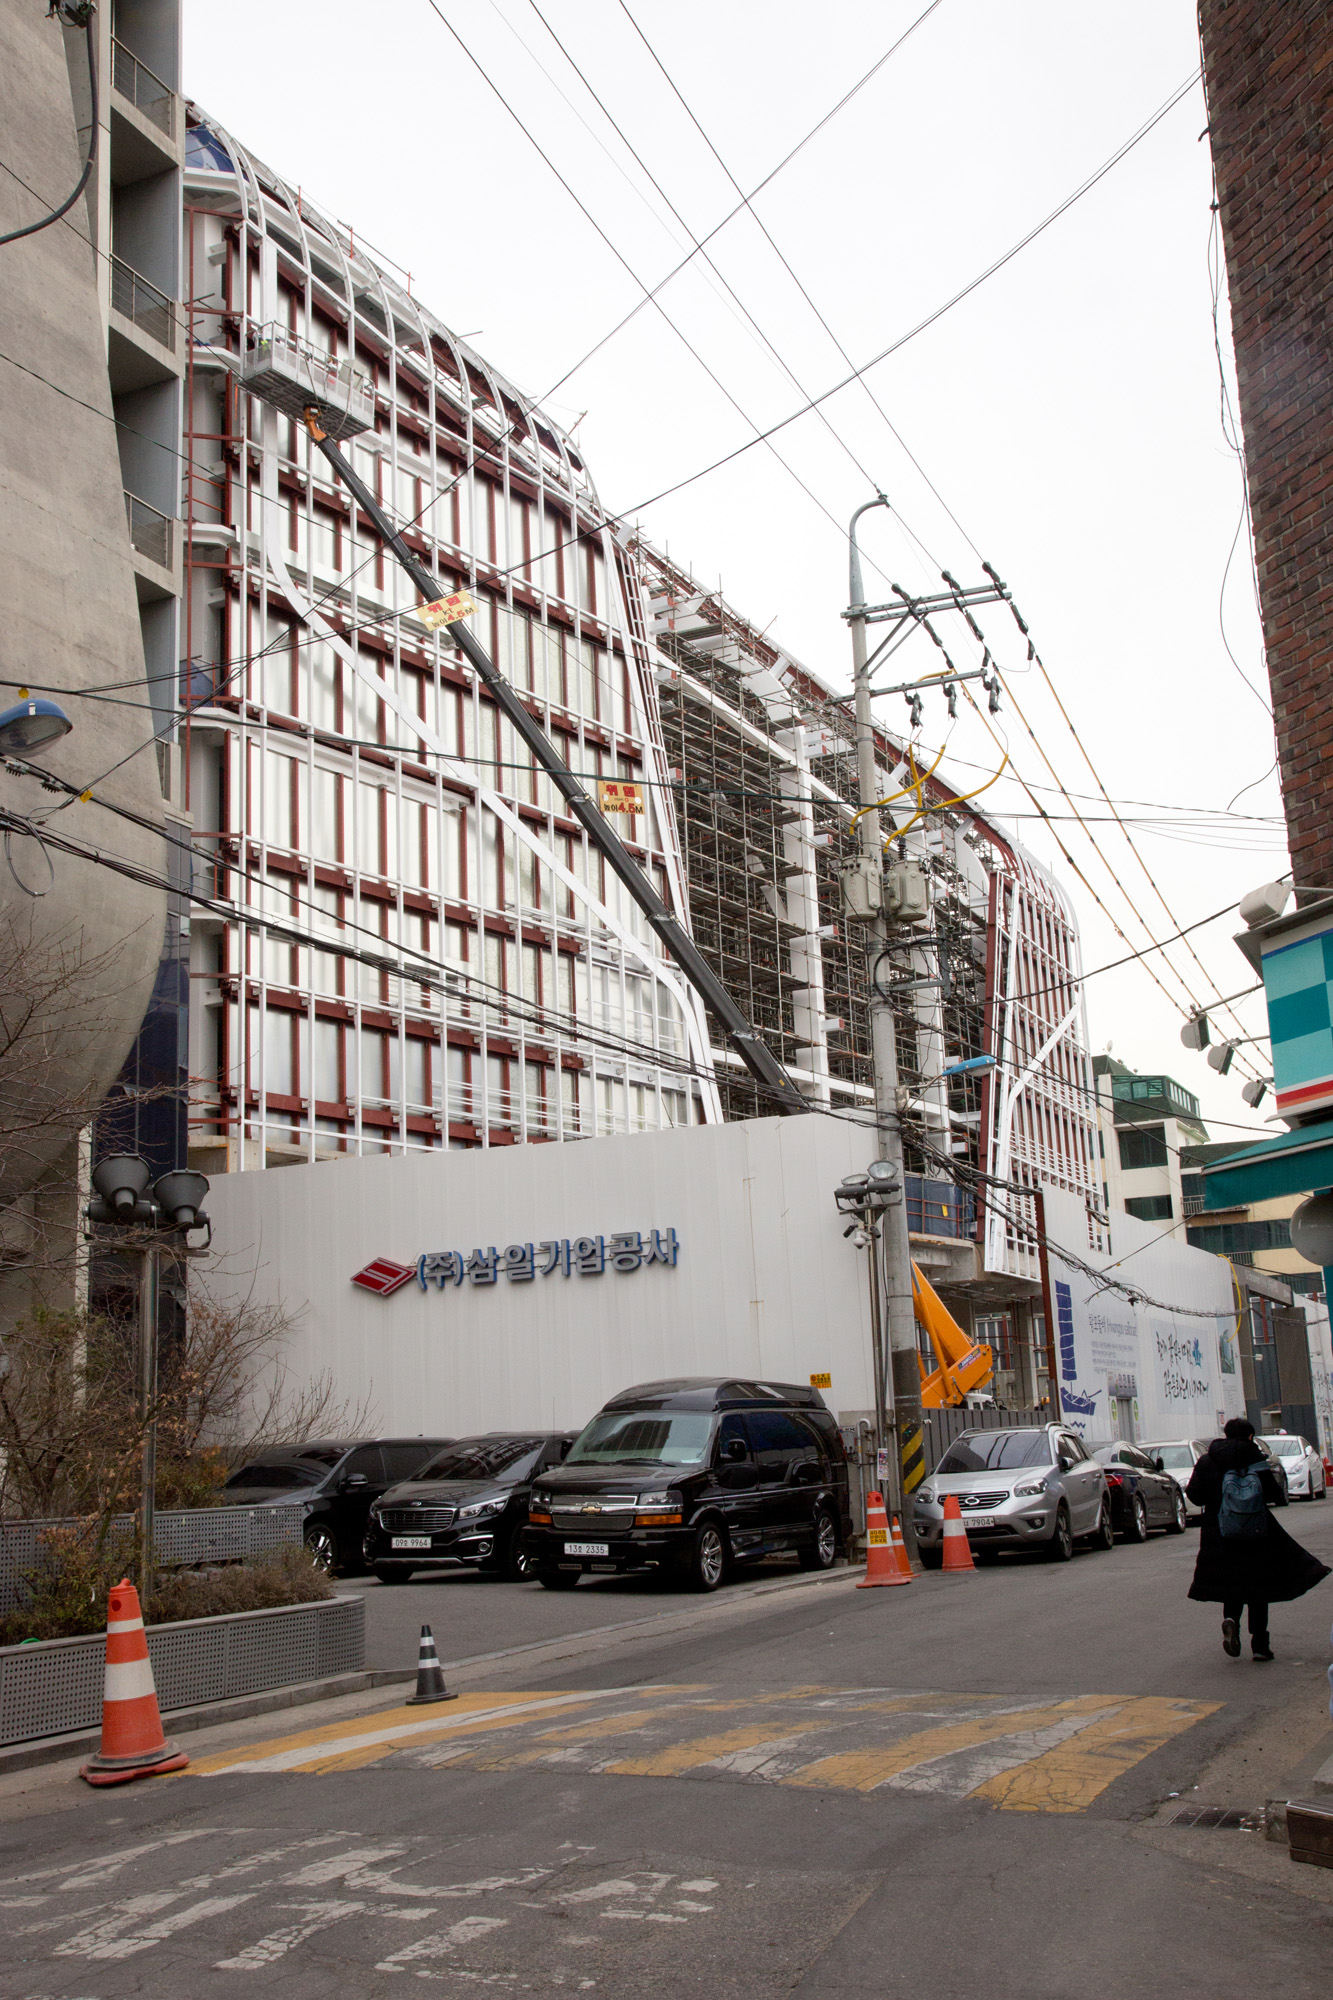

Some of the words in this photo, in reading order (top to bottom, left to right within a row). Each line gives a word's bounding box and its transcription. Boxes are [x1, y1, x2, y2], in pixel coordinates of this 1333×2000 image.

[417, 1228, 679, 1290] (주)삼일기업공사
[971, 1518, 990, 1526] 7904
[411, 1538, 428, 1547] 9964
[586, 1545, 605, 1554] 2335
